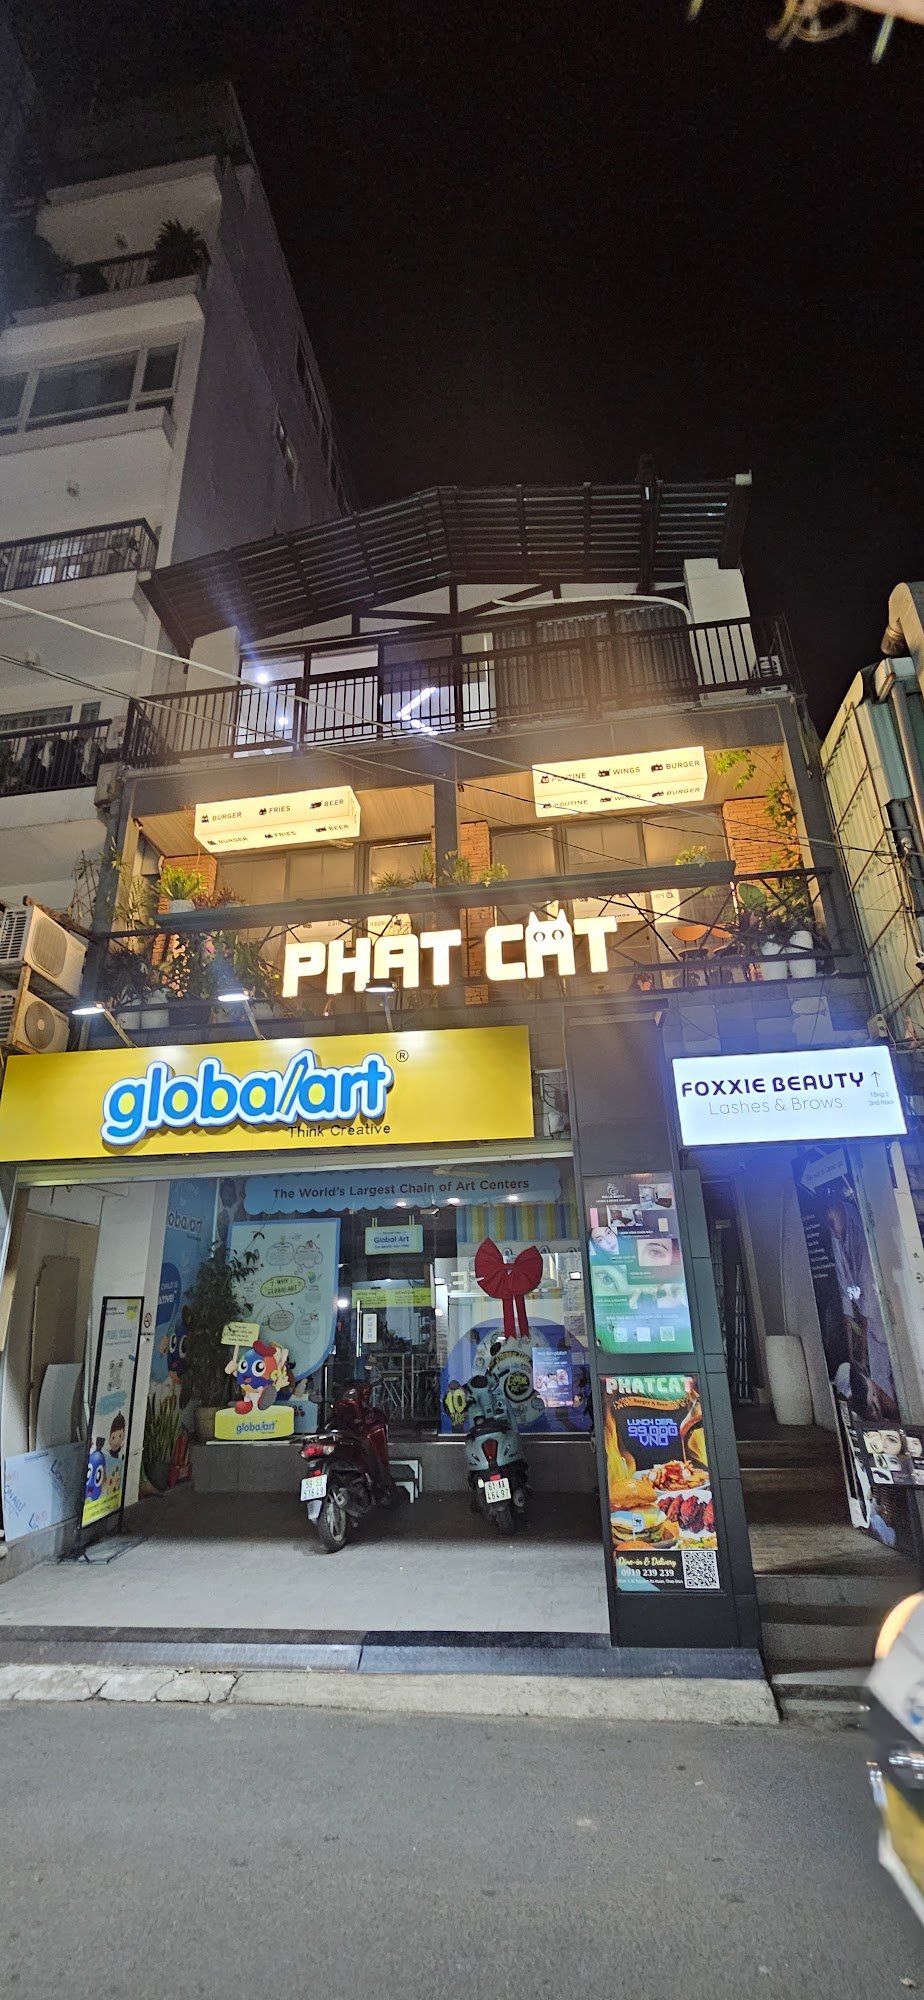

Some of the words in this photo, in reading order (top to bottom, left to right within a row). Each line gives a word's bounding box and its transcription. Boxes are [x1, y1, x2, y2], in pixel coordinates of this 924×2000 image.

[612, 766, 641, 775] WINGS
[665, 760, 700, 770] BURGER
[666, 787, 700, 796] BURGER
[211, 811, 242, 822] BURGER
[268, 805, 291, 814] FRIES
[324, 798, 344, 807] BEER
[218, 836, 248, 845] BURGER
[274, 830, 296, 838] FRIES
[282, 928, 462, 998] PHAT
[485, 908, 618, 982] CAT
[681, 1078, 766, 1097] FOXXIE
[772, 1072, 864, 1092] BEAUTY
[708, 1098, 770, 1116] Lashes
[775, 1098, 787, 1111] &
[792, 1095, 843, 1111] Brows
[288, 1125, 324, 1138] Think
[330, 1123, 391, 1137] Creative
[273, 1188, 295, 1199] The
[299, 1186, 345, 1199] World's
[350, 1184, 396, 1197] Largest
[400, 1182, 435, 1194] Chain
[439, 1181, 454, 1192] of
[456, 1180, 476, 1191] Art
[480, 1178, 530, 1190] Centers
[373, 1235, 397, 1244] Global
[605, 1377, 693, 1394] PHATCAT
[618, 1556, 643, 1566] Dine-in
[643, 1556, 651, 1566] &
[651, 1556, 677, 1568] Delivery
[642, 1568, 658, 1577] 239
[659, 1568, 675, 1577] 239
